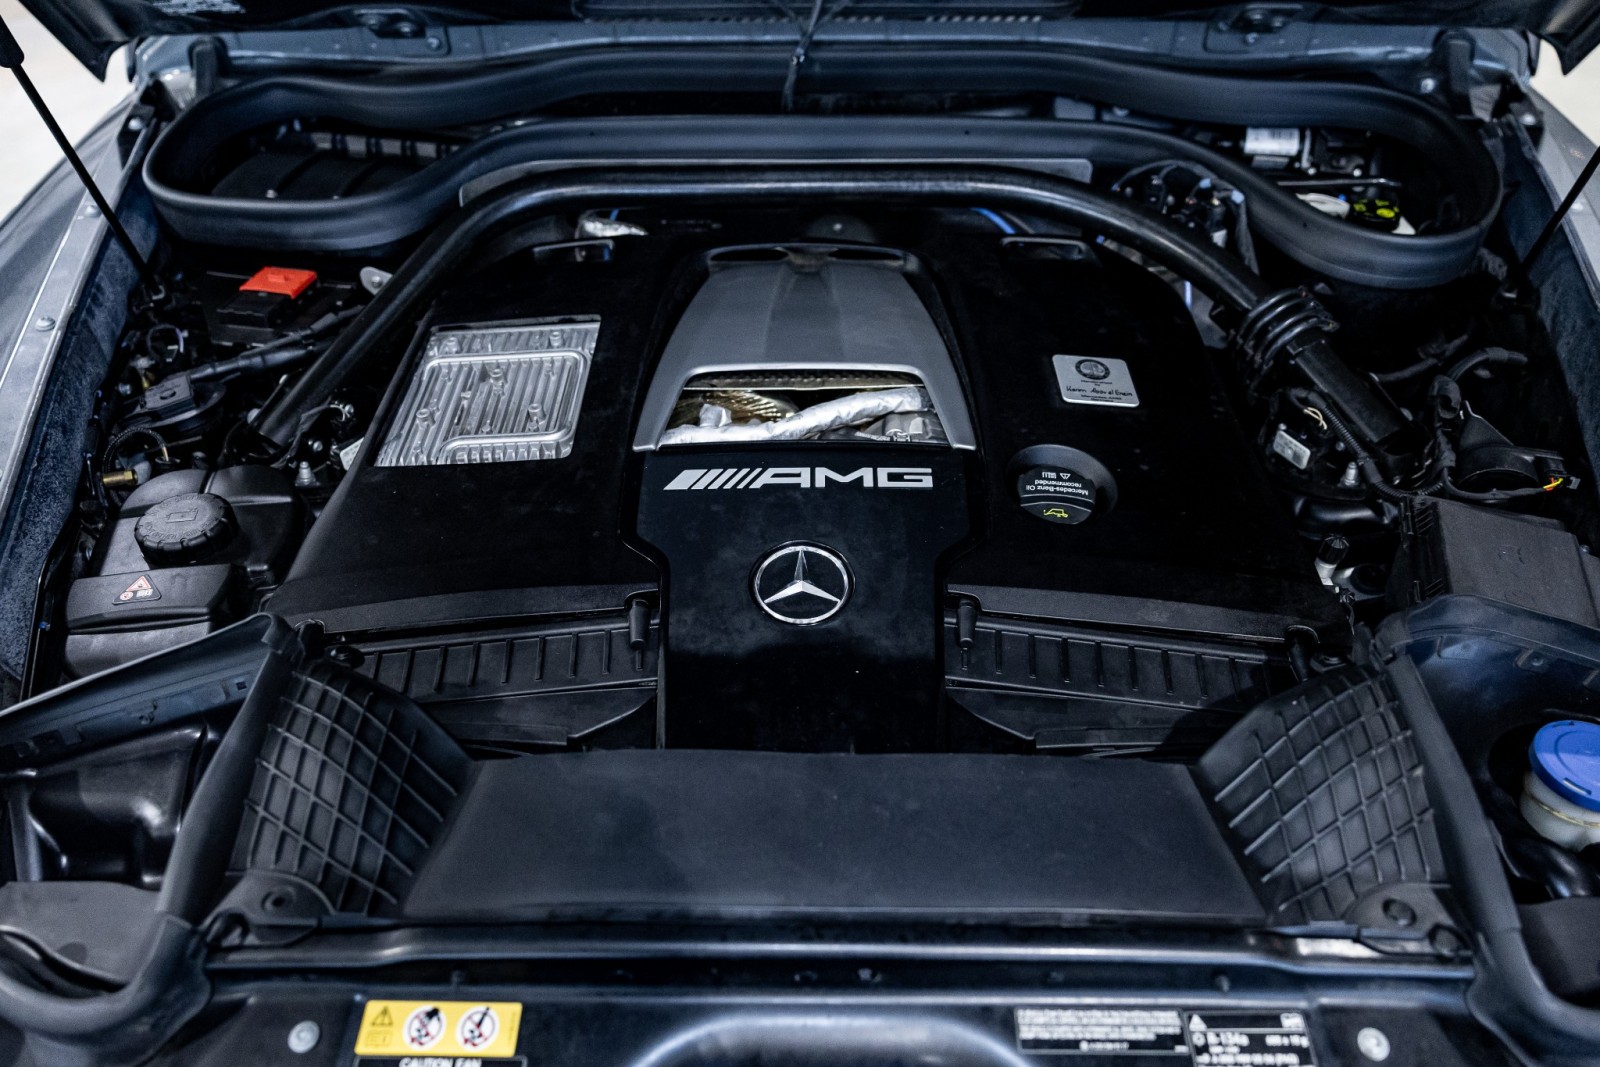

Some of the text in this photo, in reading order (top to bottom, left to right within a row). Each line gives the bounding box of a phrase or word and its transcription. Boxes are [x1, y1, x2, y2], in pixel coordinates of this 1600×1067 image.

[749, 467, 933, 488] AMG
[1034, 479, 1082, 488] recommended
[1037, 485, 1088, 495] Mercedes-Benz
